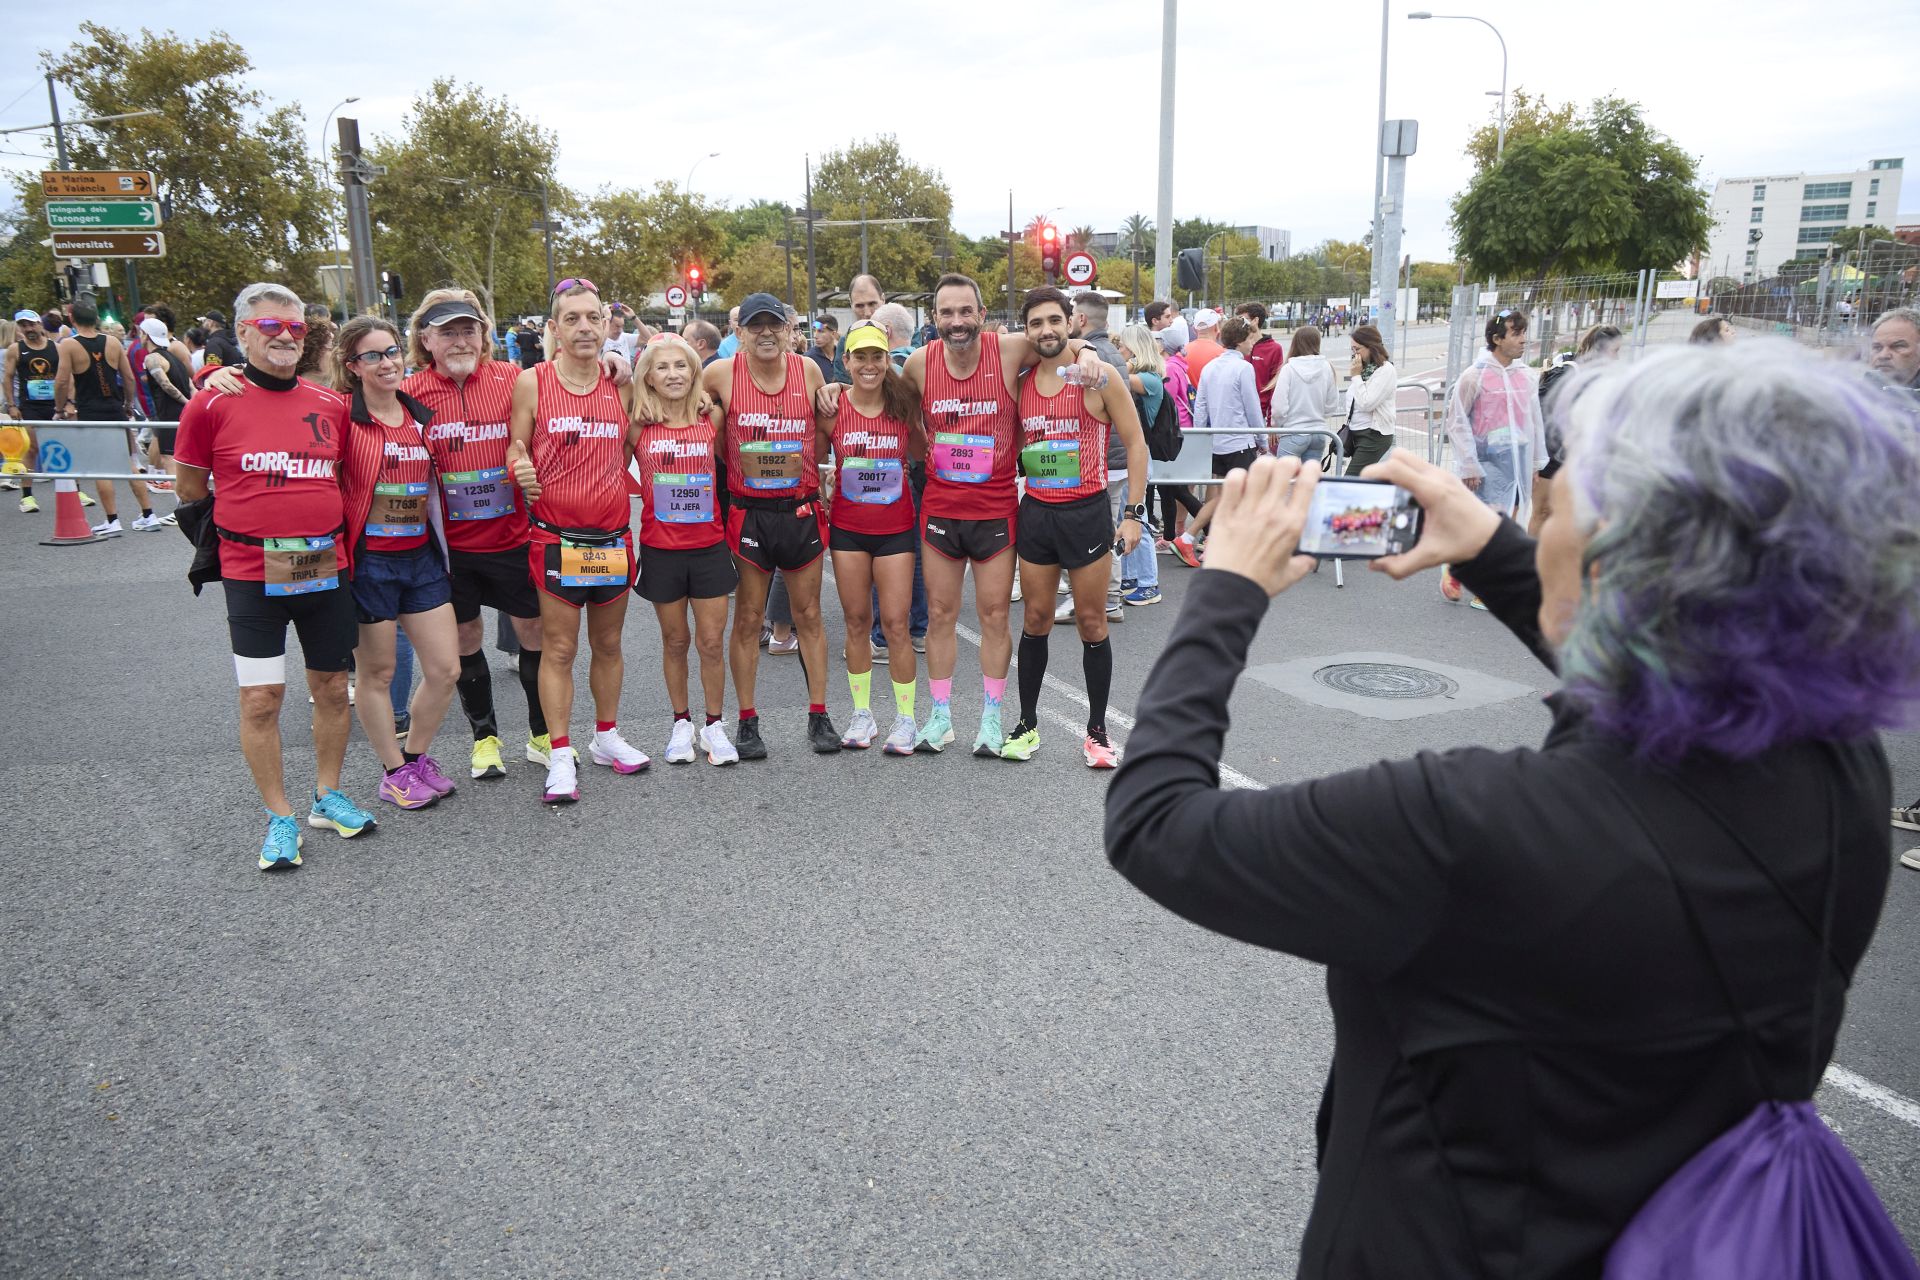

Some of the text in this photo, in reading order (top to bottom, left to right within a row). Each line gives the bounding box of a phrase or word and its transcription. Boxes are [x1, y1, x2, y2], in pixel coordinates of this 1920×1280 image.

[45, 175, 95, 183] La Marina
[50, 206, 86, 214] avinguda
[51, 215, 101, 224] Tarongers
[55, 241, 114, 249] universitats
[930, 398, 998, 417] CORRELIANA
[548, 416, 619, 439] CORRELIANA
[737, 413, 806, 433] CORRELIANA
[429, 421, 508, 443] CORRELIANA
[843, 431, 898, 450] CORRELIANA
[649, 439, 708, 458] CORRELIANA
[950, 448, 974, 458] 2893
[756, 455, 787, 465] 15922
[1040, 454, 1057, 464] 810
[952, 462, 971, 470] LOLO
[760, 469, 784, 477] PRESI
[858, 472, 887, 481] 20017
[1041, 468, 1057, 477] XAVI
[464, 483, 496, 495] 12385
[670, 488, 700, 498] 12950
[473, 499, 491, 508] EDU
[670, 502, 700, 511] LA JEFA
[582, 551, 607, 561] 8243
[291, 568, 319, 581] TRIPLE
[580, 565, 610, 574] MIGUEL
